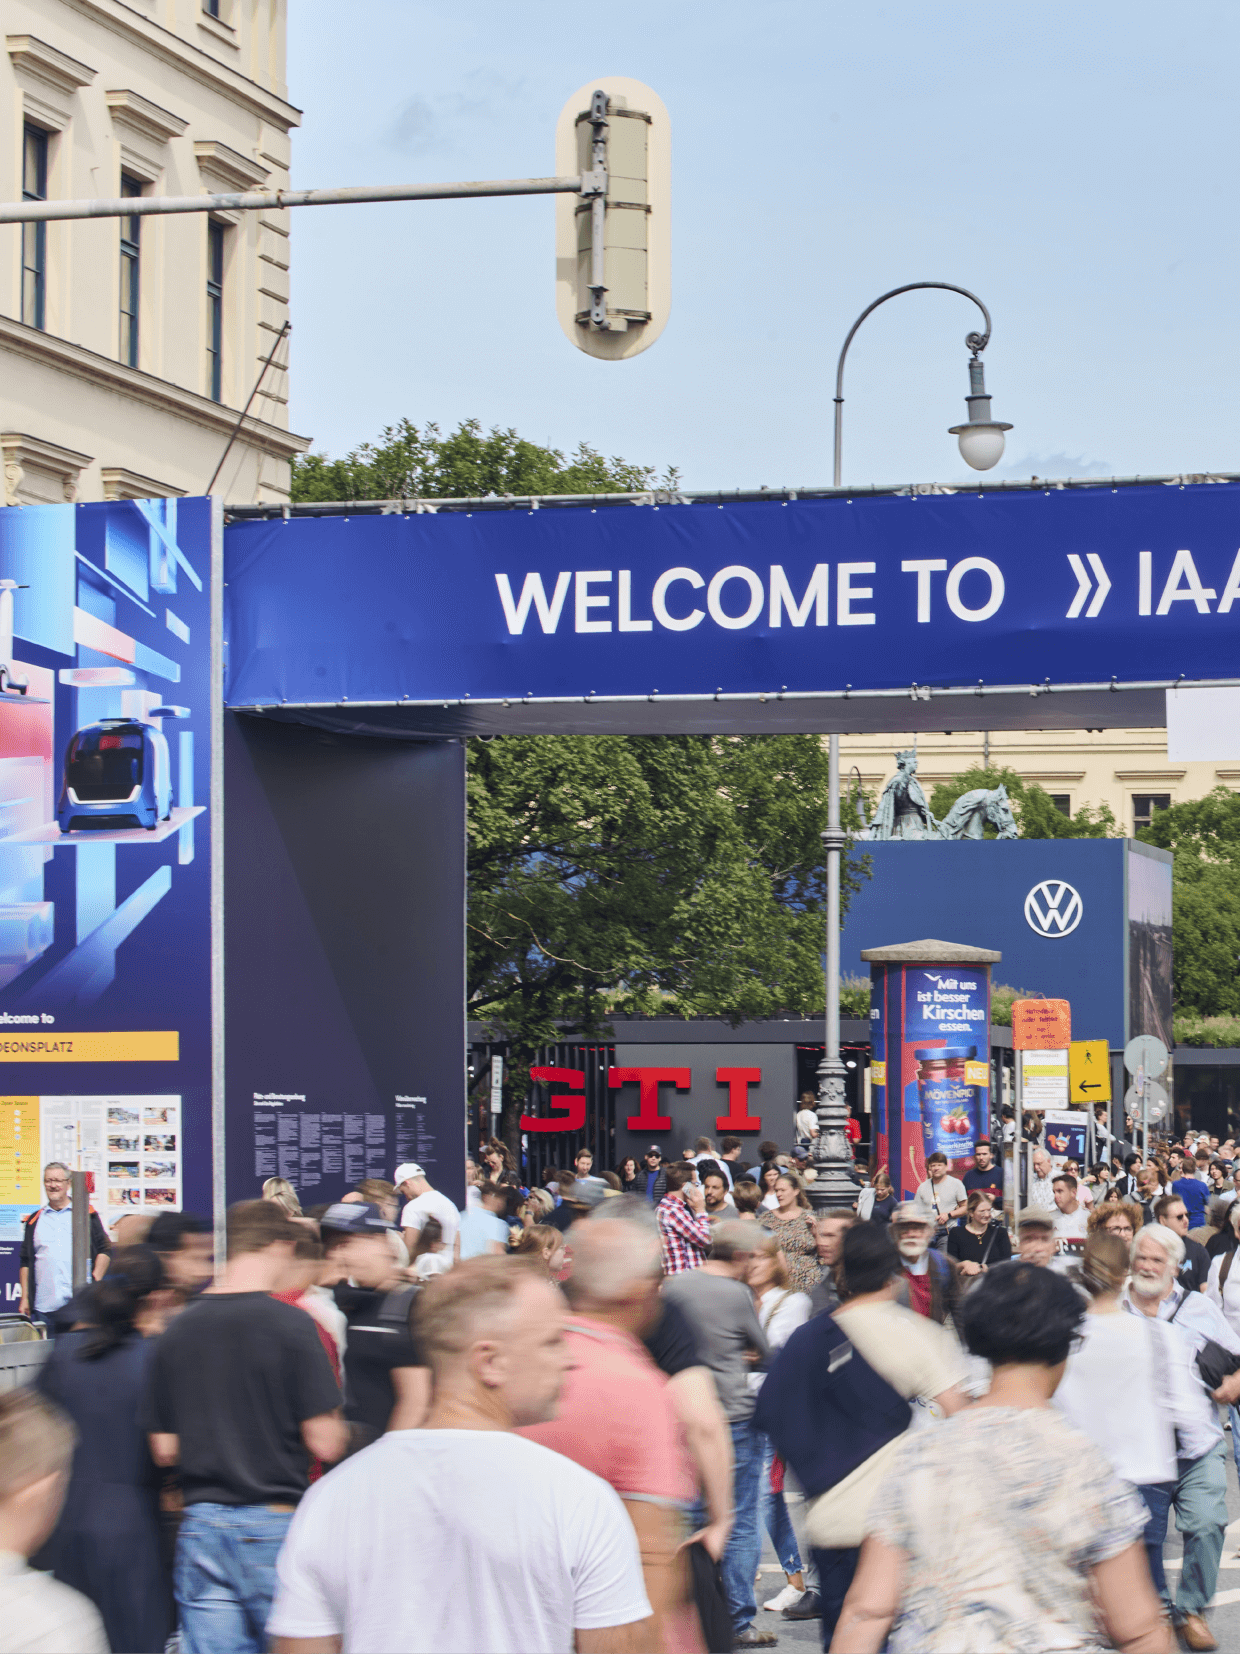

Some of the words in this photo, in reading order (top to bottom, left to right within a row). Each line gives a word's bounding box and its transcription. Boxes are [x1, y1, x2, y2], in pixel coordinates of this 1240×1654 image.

[495, 562, 876, 635] WELCOME
[901, 556, 1005, 623] TO
[1024, 880, 1083, 938] VW
[938, 978, 958, 990] Mit
[959, 981, 977, 991] uns
[917, 991, 932, 1002] ist
[933, 990, 971, 1003] besser
[0, 1012, 40, 1024] elcome
[41, 1013, 55, 1024] to
[922, 1003, 985, 1021] Kirschen
[938, 1022, 973, 1032] essen.
[0, 1041, 73, 1053] EONSPLATZ
[519, 1066, 761, 1132] GTI
[1075, 1134, 1085, 1154] 1
[6, 1283, 22, 1301] IA
